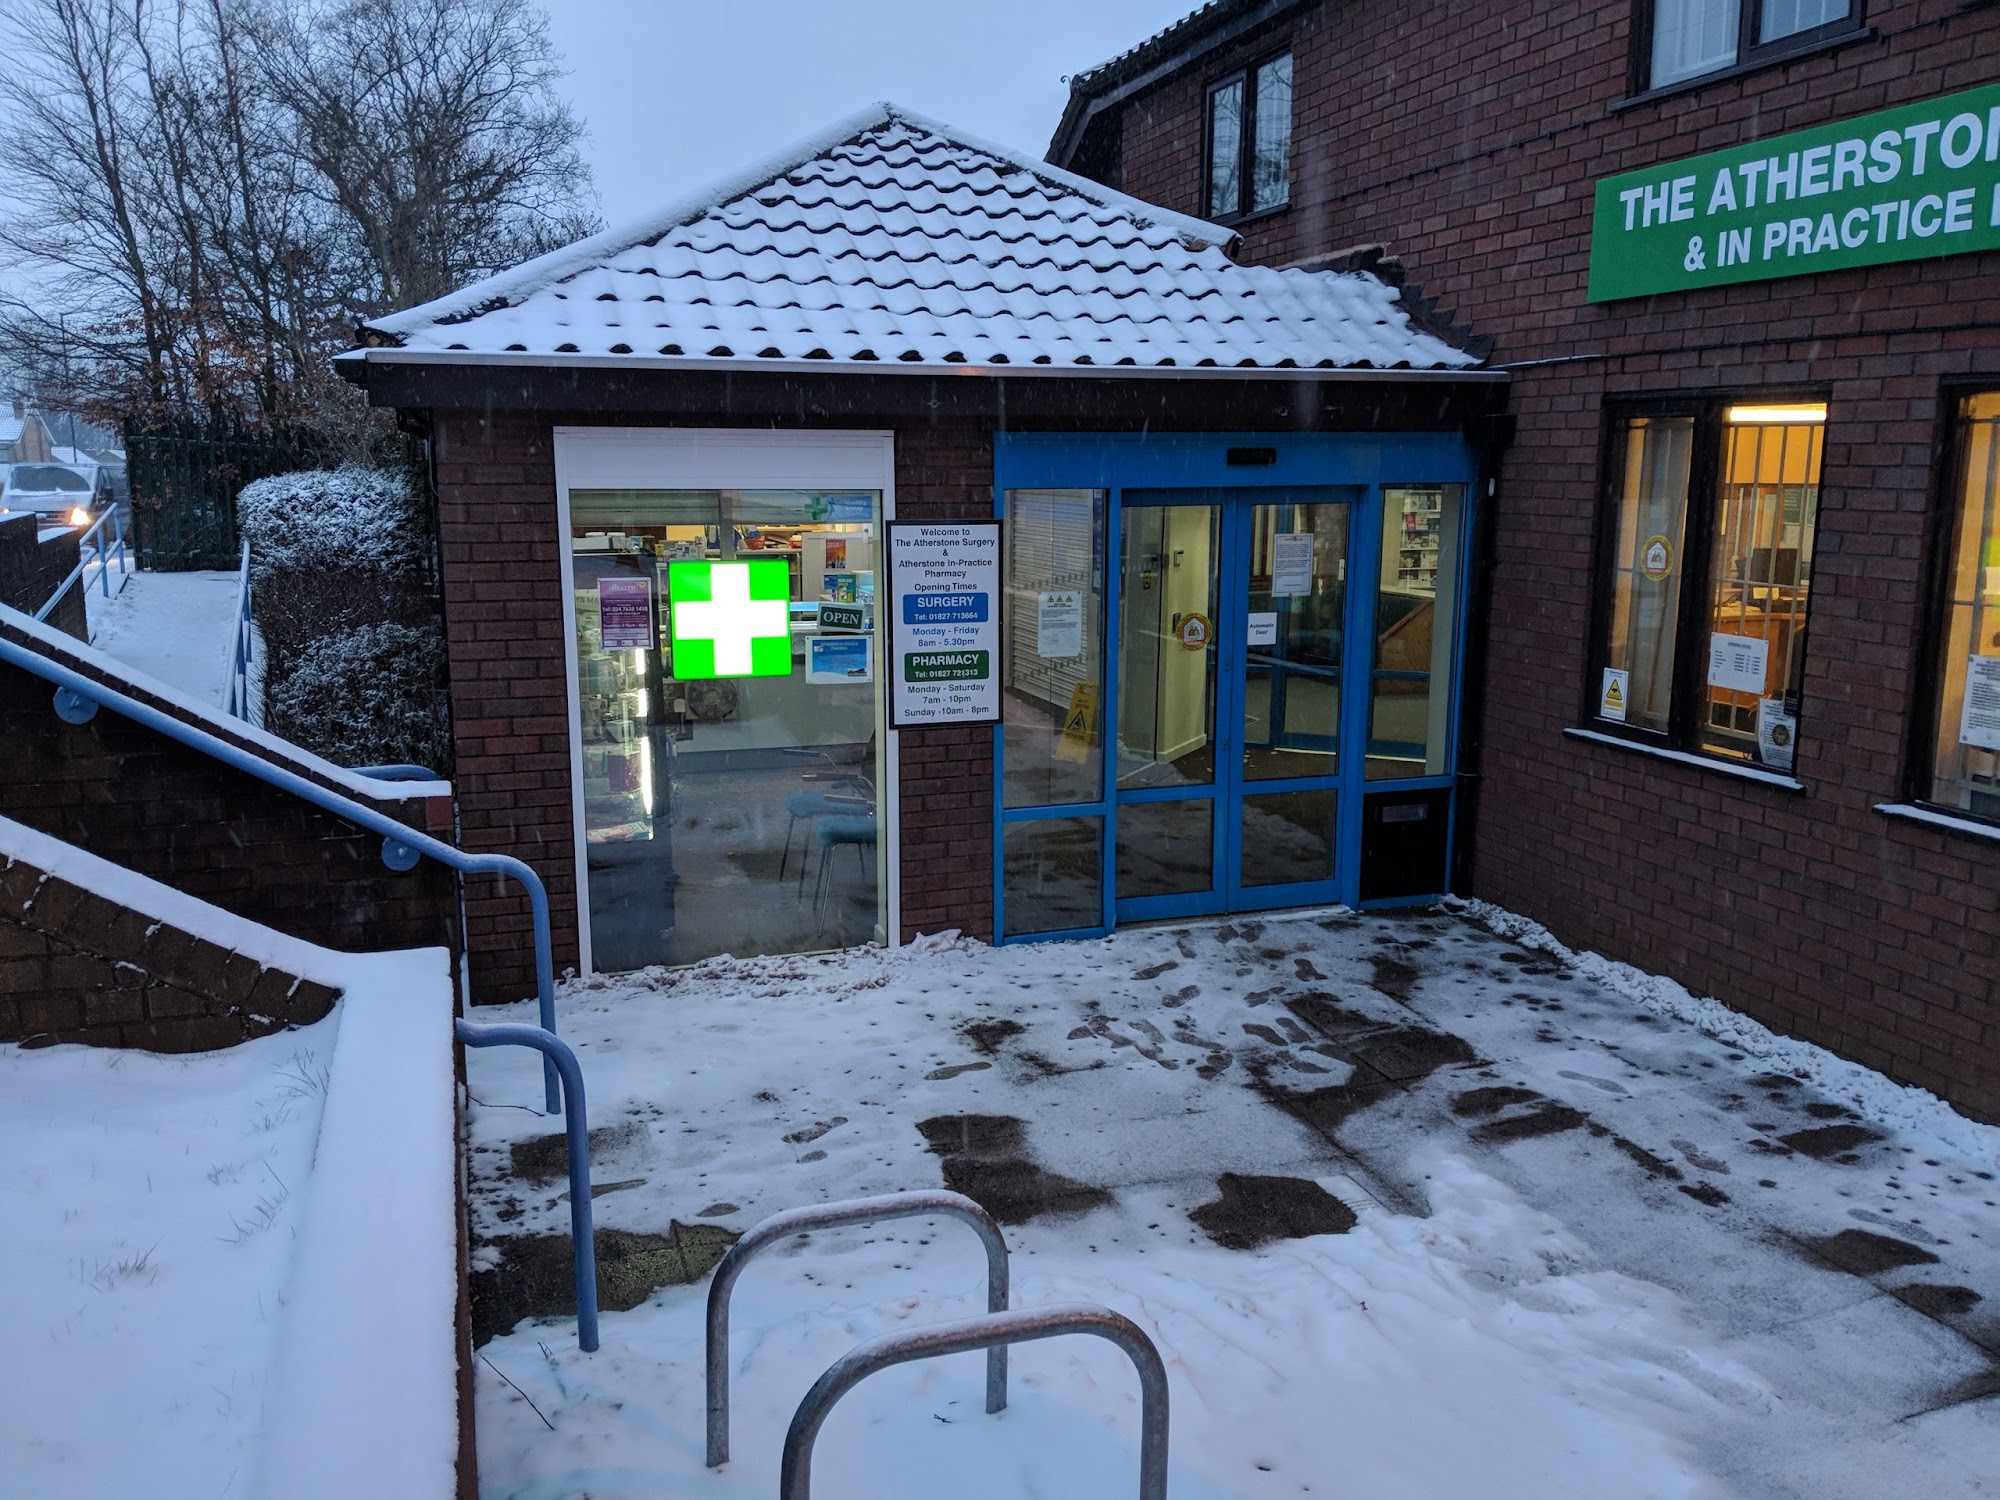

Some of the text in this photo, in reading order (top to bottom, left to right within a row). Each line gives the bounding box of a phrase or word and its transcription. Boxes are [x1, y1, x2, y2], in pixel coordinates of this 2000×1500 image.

[1619, 175, 1696, 231] THE
[1683, 235, 1706, 272] &
[1716, 227, 1752, 267] IN
[1763, 187, 1976, 260] PRACTICE
[920, 528, 970, 536] Welcome to
[895, 538, 995, 548] The Atherstone Surgery
[898, 559, 992, 568] Atherstone In-Practice
[924, 570, 967, 579] Pharmacy
[914, 583, 950, 592] Opening
[917, 596, 974, 608] SURGERY
[823, 611, 860, 625] OPEN
[914, 611, 978, 621] Tel: 01827 713664
[912, 628, 946, 636] Monday
[953, 626, 980, 635] Friday
[918, 639, 936, 647] 8am
[944, 638, 974, 647] 5.30pm
[912, 654, 979, 666] PHARMACY
[952, 669, 978, 677] 721313
[907, 685, 941, 694] Monday
[948, 683, 985, 692] Saturday
[922, 696, 940, 704] 7am
[949, 695, 971, 704] 10pm
[904, 708, 936, 717] Sunday
[971, 706, 989, 714] 8pm
